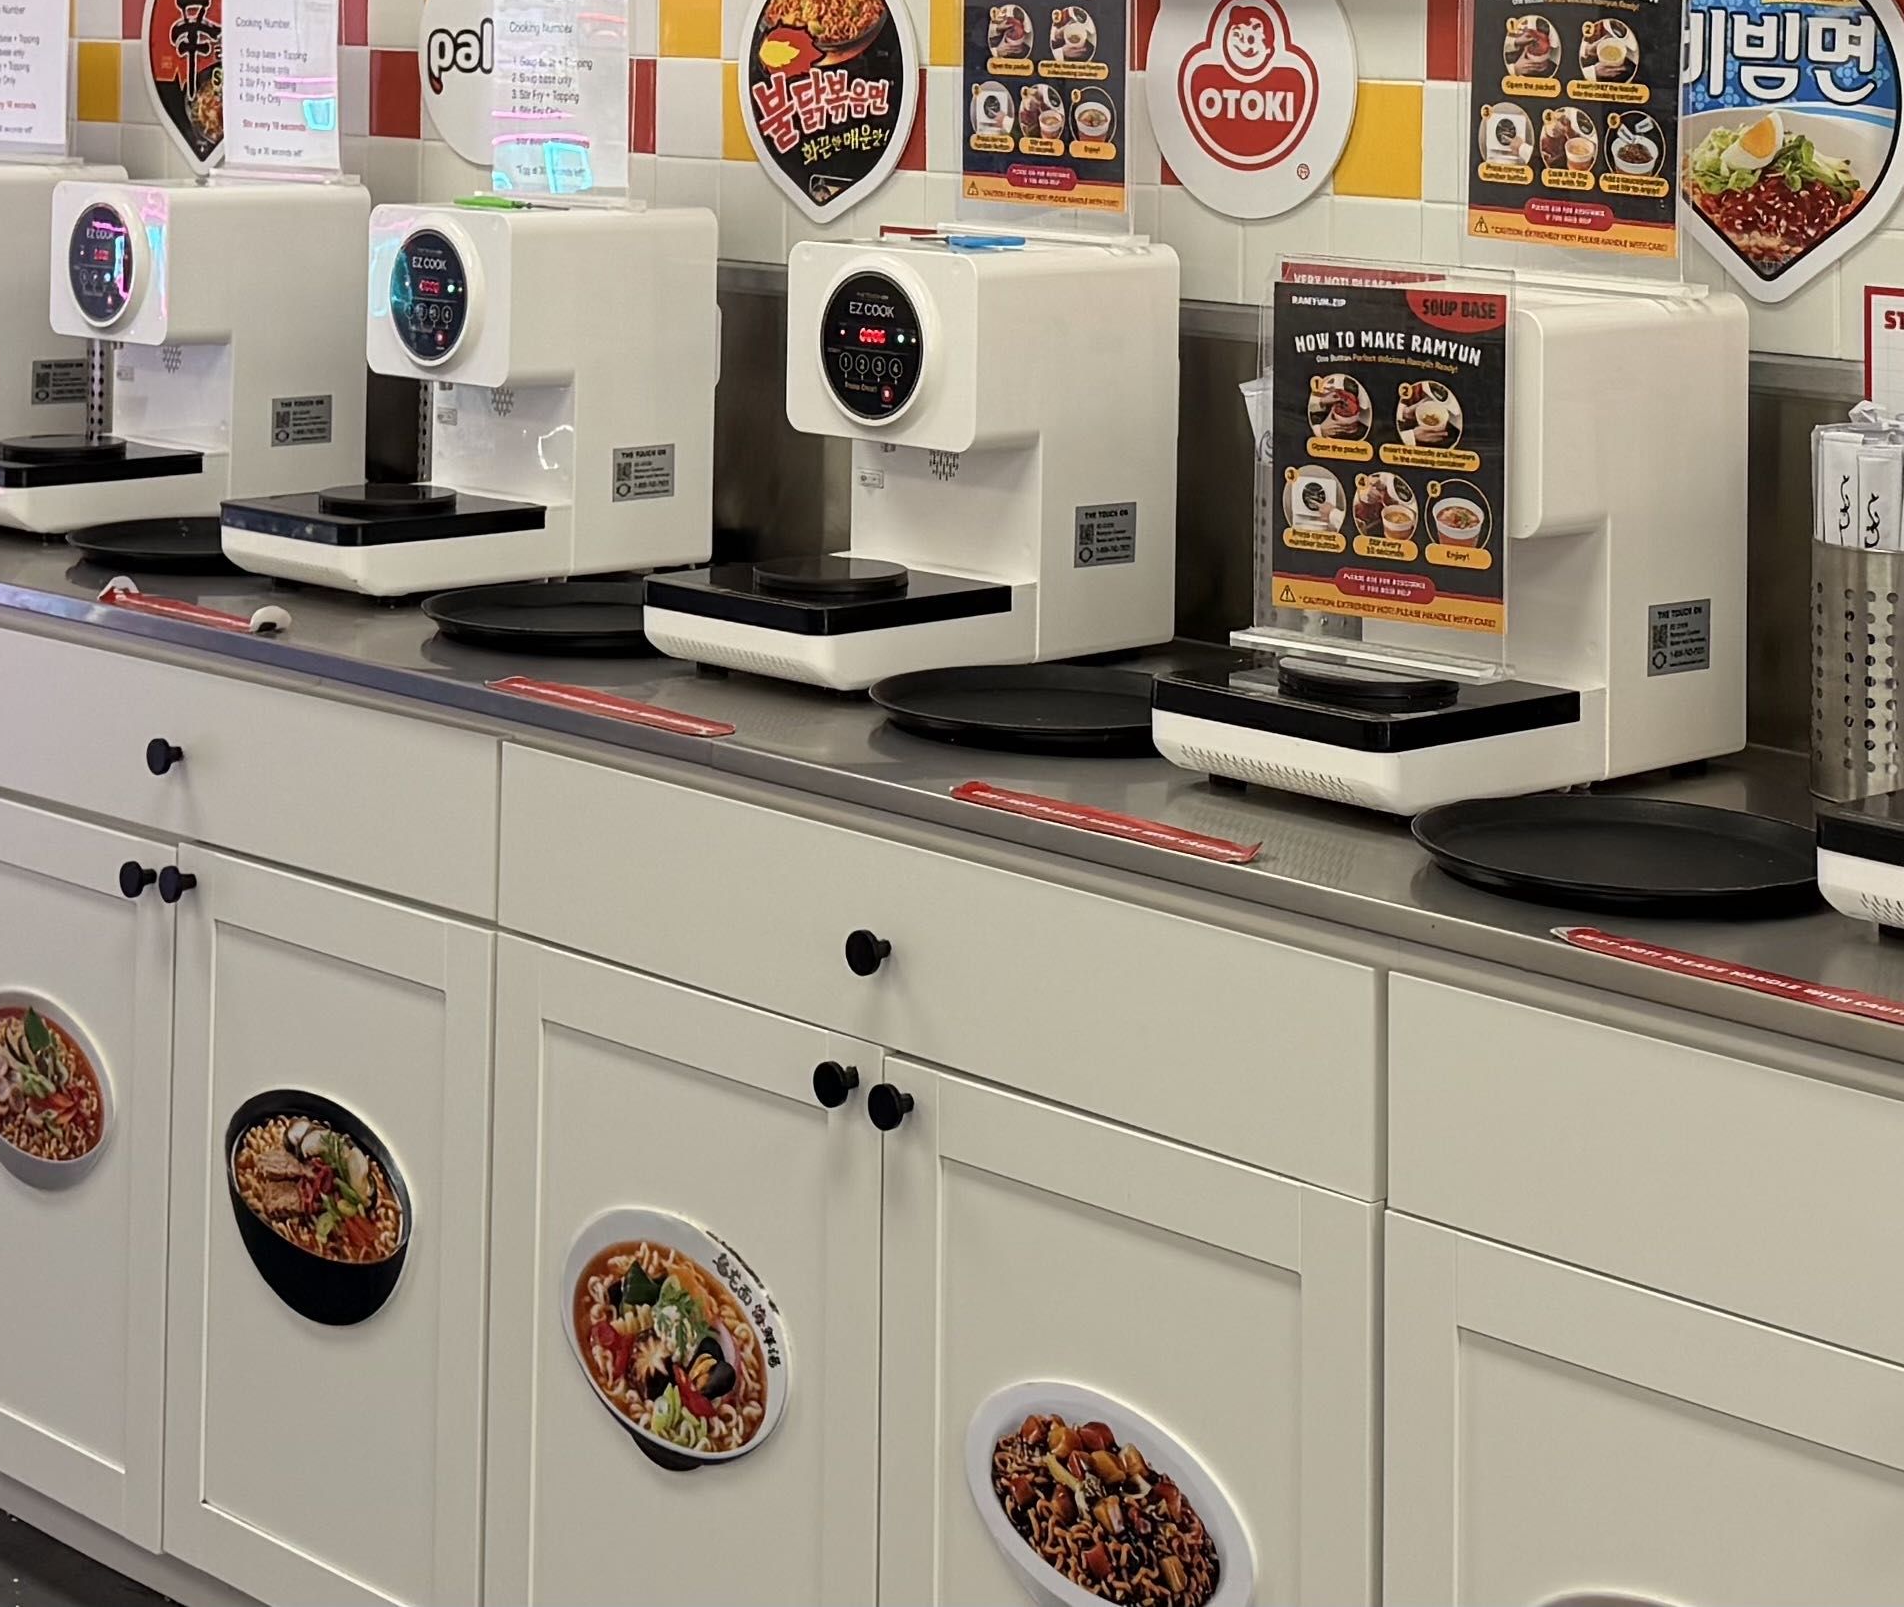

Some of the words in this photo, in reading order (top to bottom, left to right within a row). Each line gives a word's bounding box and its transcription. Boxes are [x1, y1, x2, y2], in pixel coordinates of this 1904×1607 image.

[753, 68, 889, 154] 불닭볶음면
[1199, 88, 1294, 123] OTOKI
[1422, 299, 1457, 316] SOUP
[1461, 302, 1496, 319] BASE
[1295, 333, 1329, 352] HOW
[1336, 331, 1355, 348] TO
[1361, 331, 1404, 350] MAKE
[1412, 334, 1481, 366] RAMYUN
